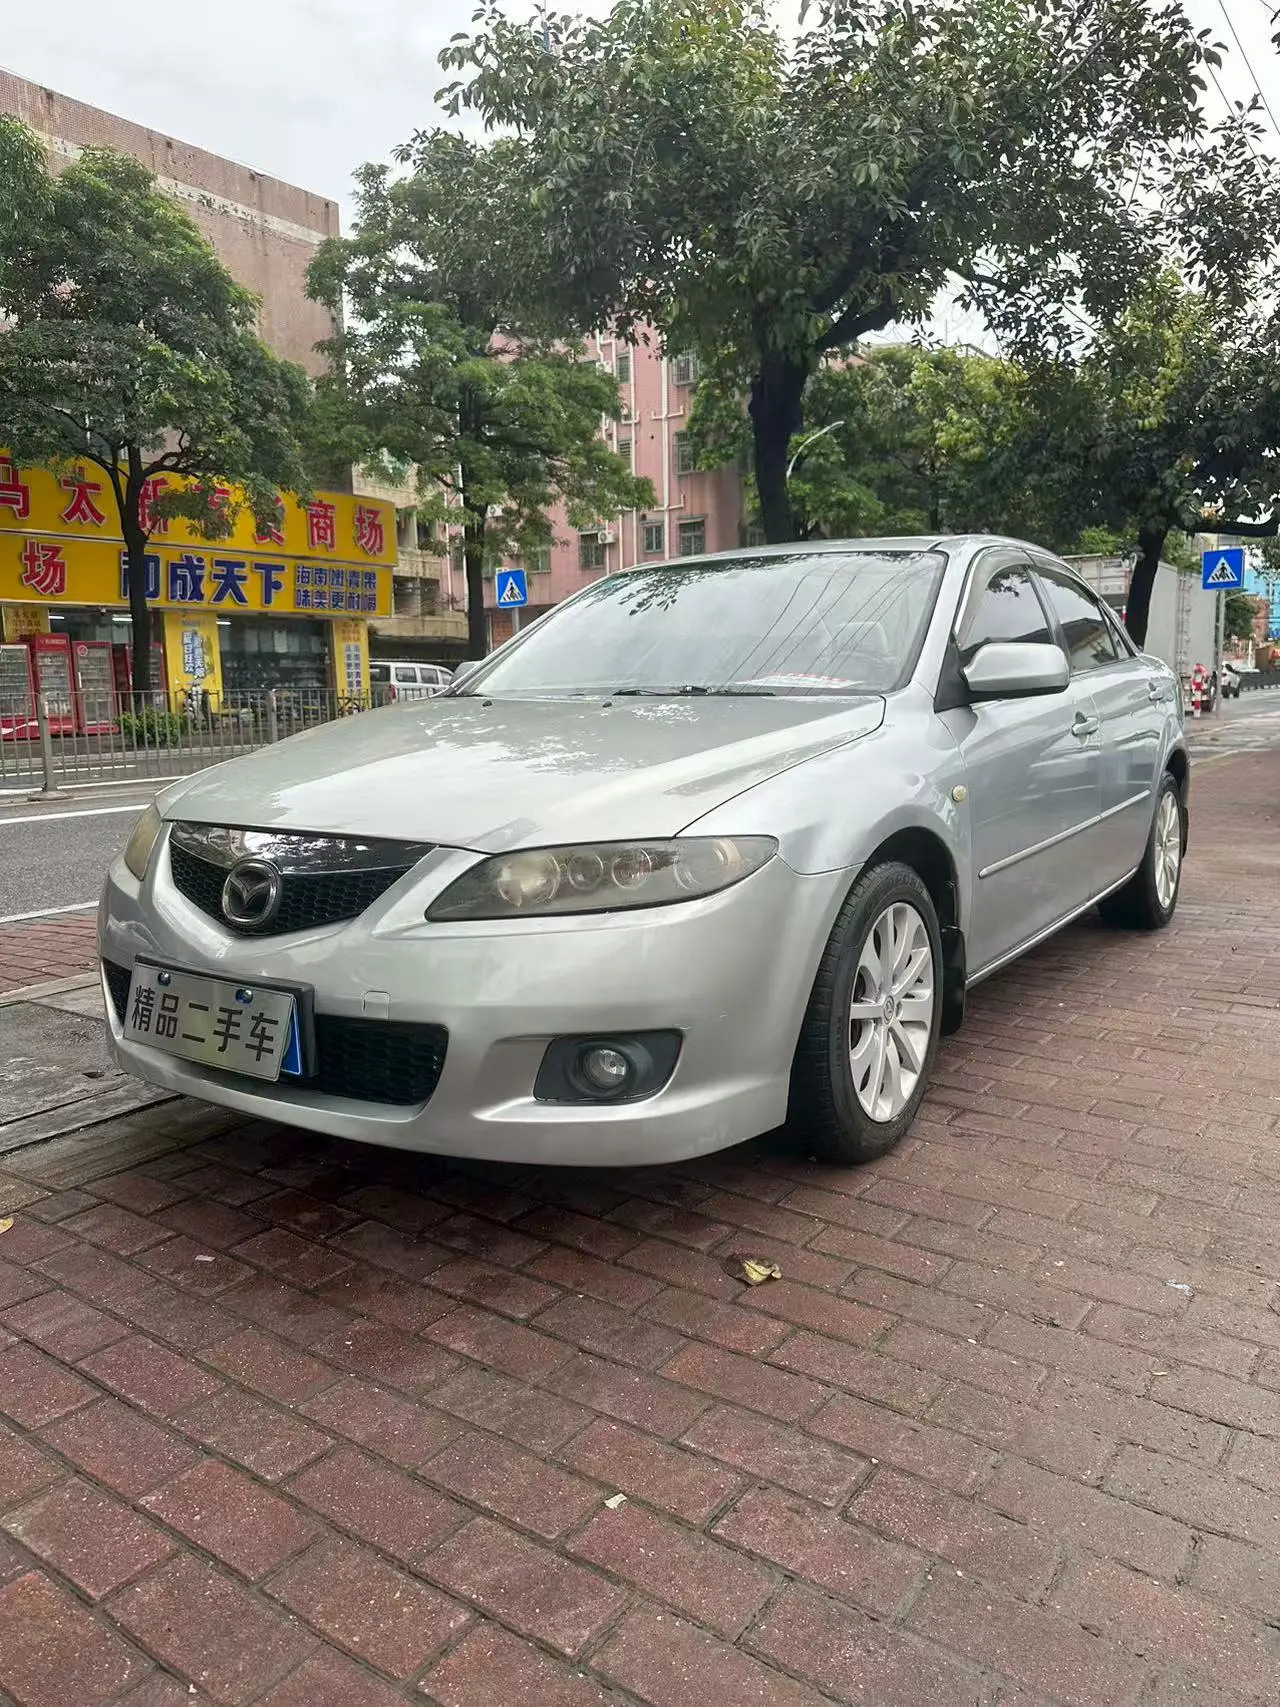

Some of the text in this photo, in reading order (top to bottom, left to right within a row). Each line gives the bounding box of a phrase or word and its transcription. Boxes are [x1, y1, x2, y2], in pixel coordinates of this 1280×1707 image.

[21, 539, 68, 596] 场
[296, 564, 377, 591] 海南嫩青果
[132, 984, 279, 1061] 精品二手车
